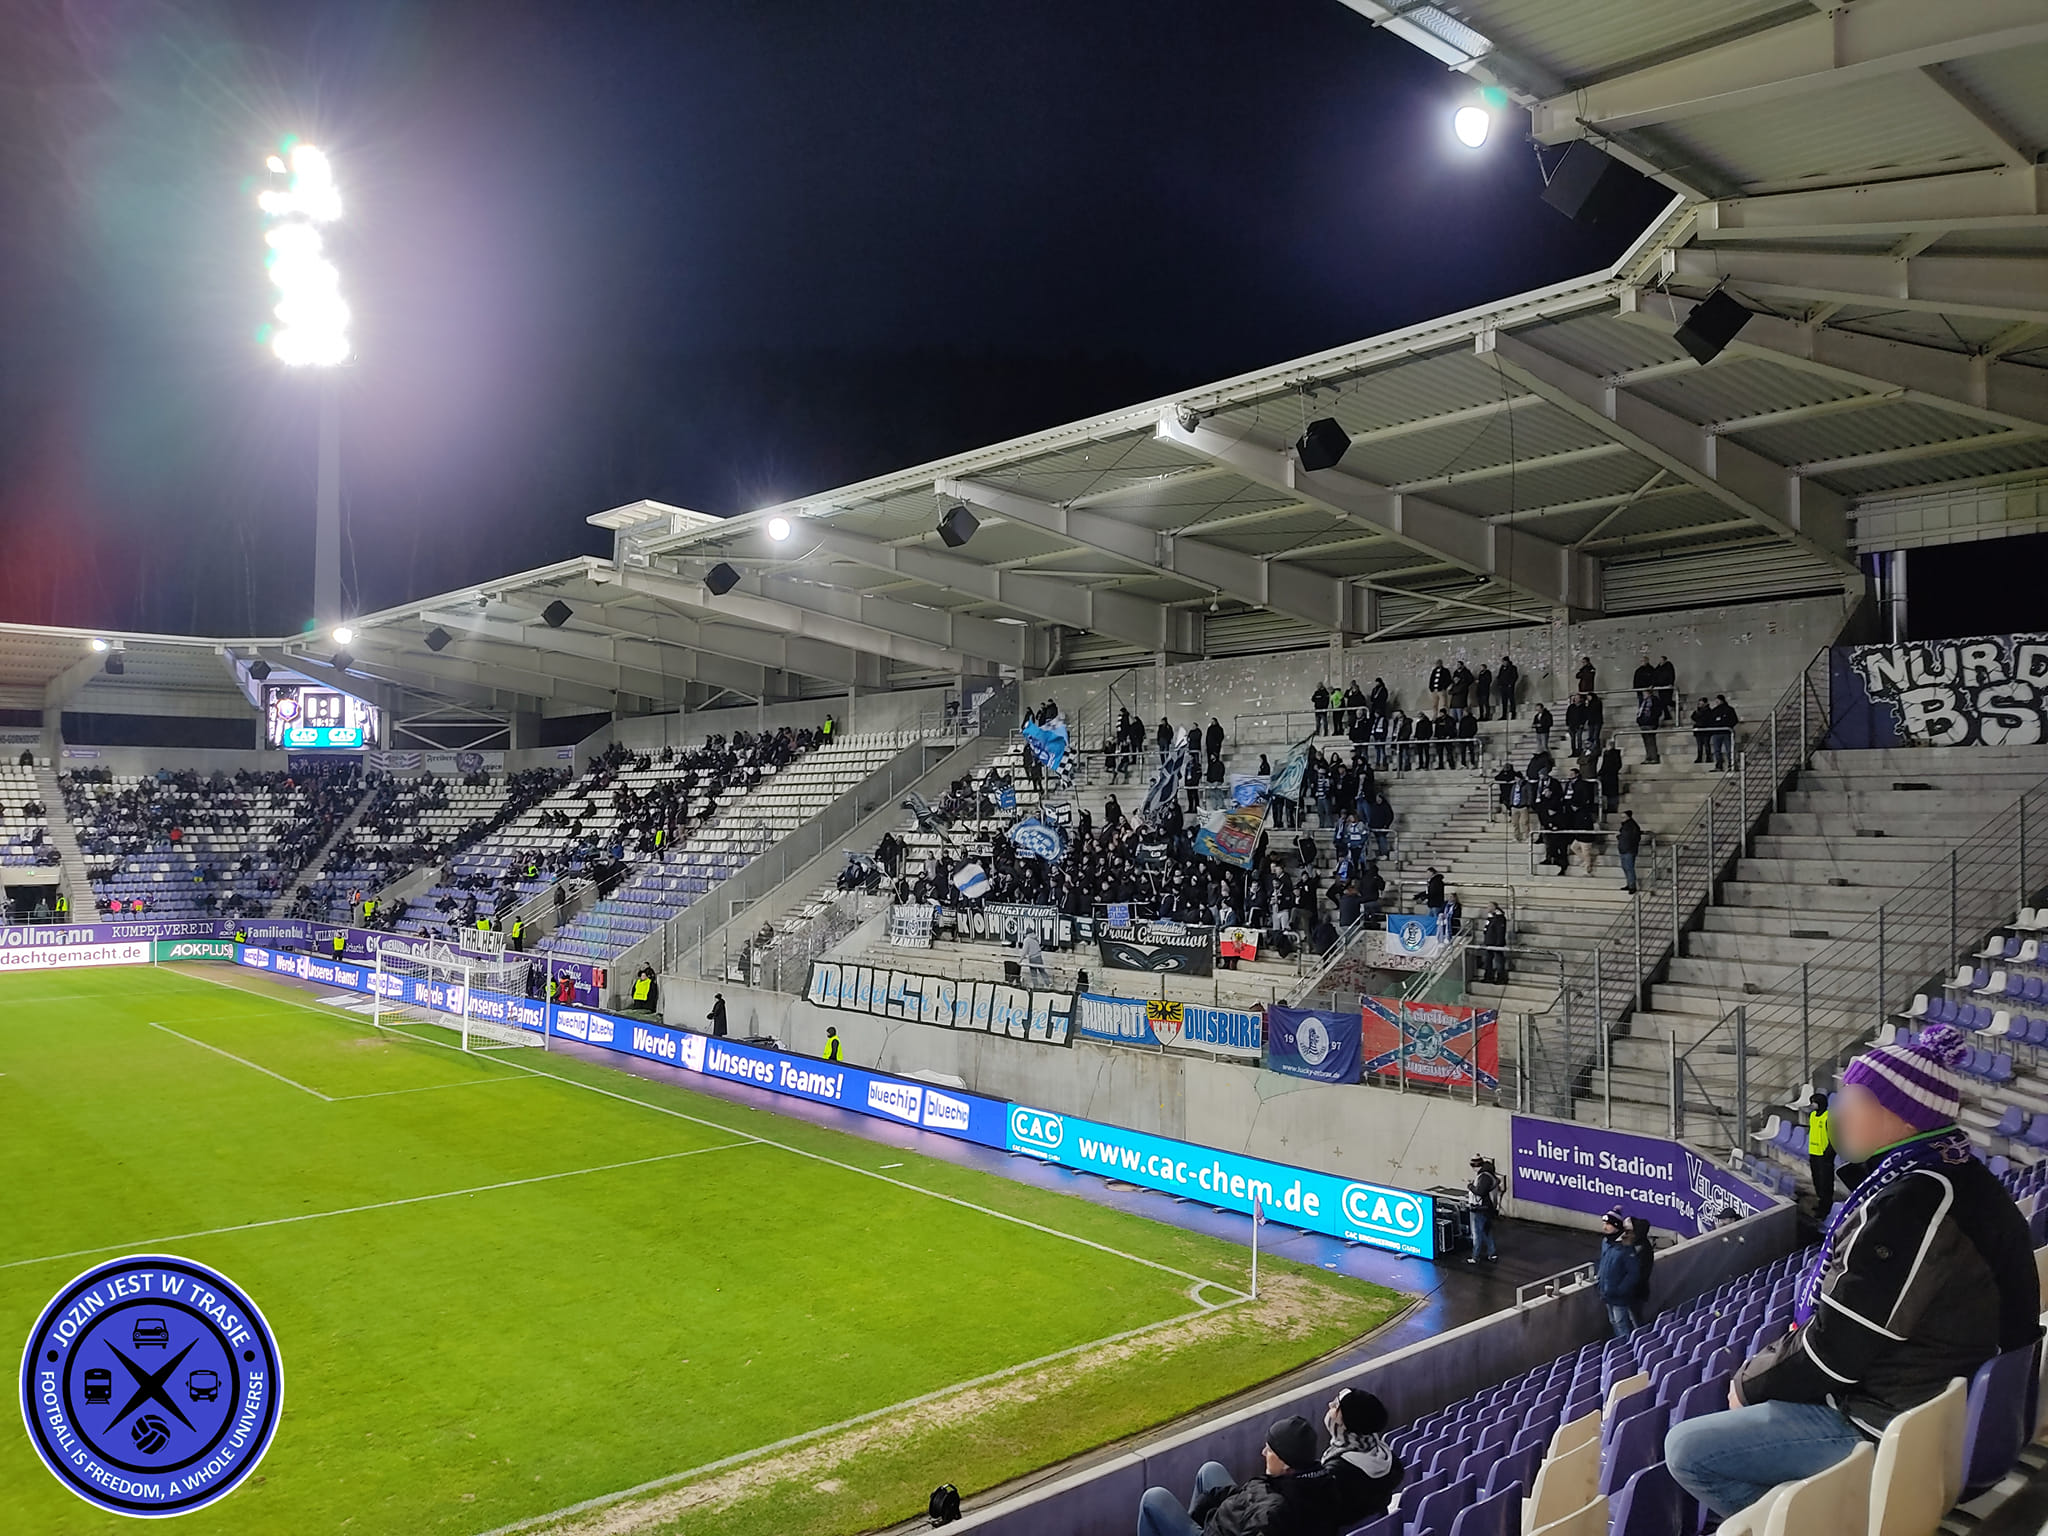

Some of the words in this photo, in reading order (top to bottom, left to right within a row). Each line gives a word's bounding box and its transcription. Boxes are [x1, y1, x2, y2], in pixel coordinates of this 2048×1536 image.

[1866, 643, 2007, 692] NUR
[112, 923, 214, 938] KUMPELVEREIN
[0, 946, 141, 965] dachtgemacht.de
[808, 962, 1073, 1045] DUISBURG
[1081, 998, 1147, 1038] RUHRPOTT
[1184, 1007, 1261, 1049] DUISBURG
[1283, 1033, 1295, 1044] 19
[633, 1027, 676, 1058] Werde
[780, 1062, 844, 1099] Teams!
[1331, 1041, 1342, 1050] 97
[870, 1085, 917, 1115] bluechip
[1016, 1109, 1058, 1142] CAC
[1079, 1137, 1320, 1217] www.cac-chem.de
[1537, 1140, 1569, 1162] hier
[1574, 1146, 1594, 1167] im
[1599, 1151, 1673, 1181] Stadion!
[1350, 1191, 1415, 1229] CAC
[1519, 1165, 1695, 1220] www.veilchen-catering.de
